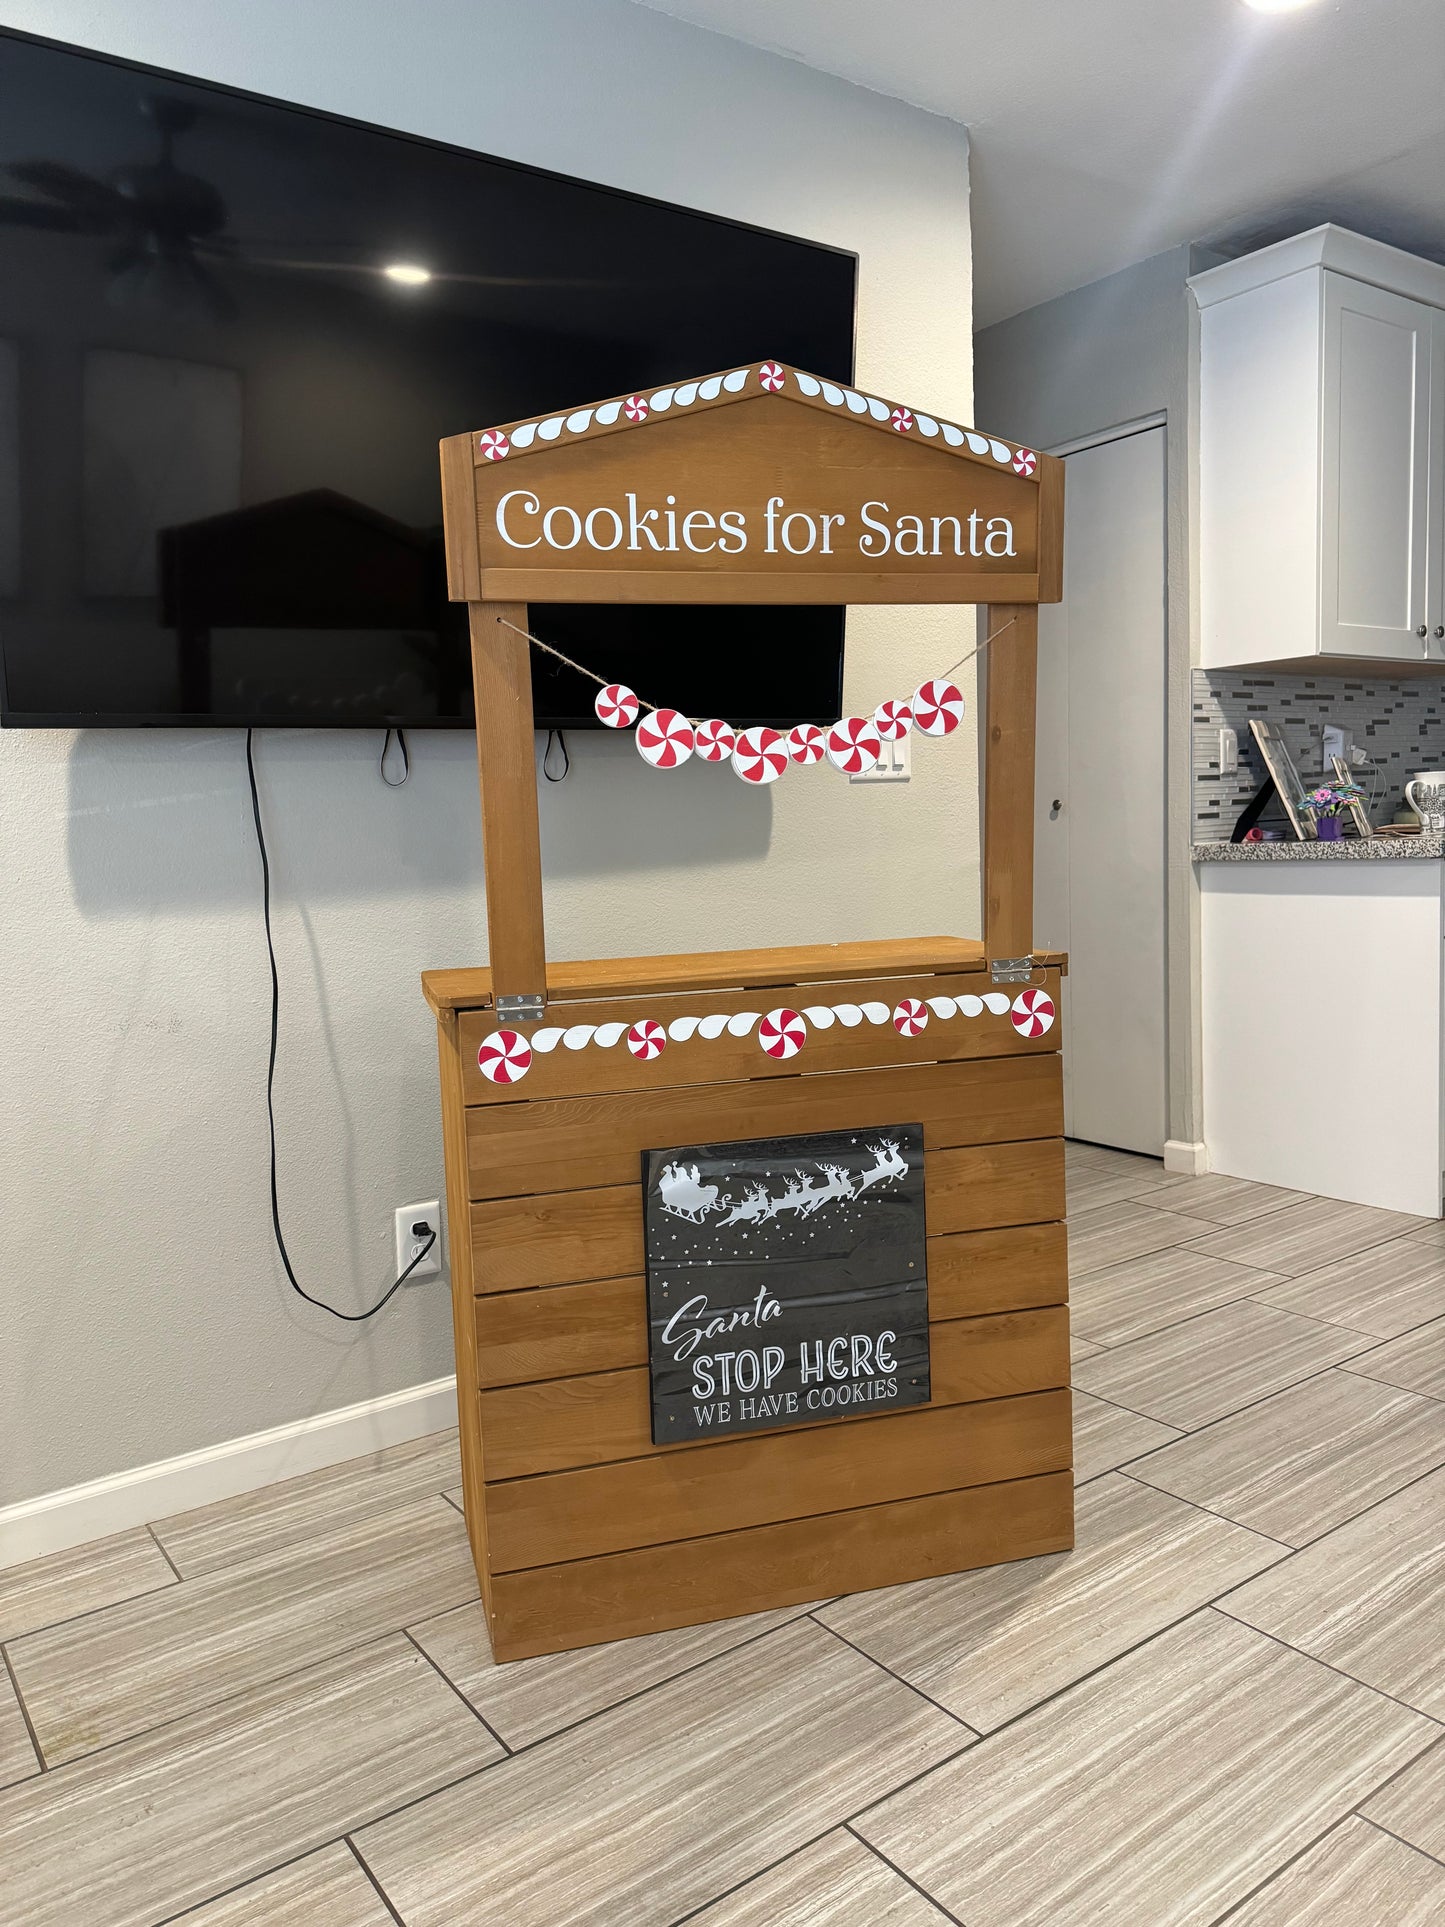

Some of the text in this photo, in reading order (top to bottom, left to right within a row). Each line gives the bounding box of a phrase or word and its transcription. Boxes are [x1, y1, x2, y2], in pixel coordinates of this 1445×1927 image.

[495, 490, 1018, 557] Cookies for Santa
[661, 1284, 784, 1362] Santa
[691, 1330, 898, 1399] STOP HERE
[693, 1377, 898, 1427] WE HAVE COOKIES
